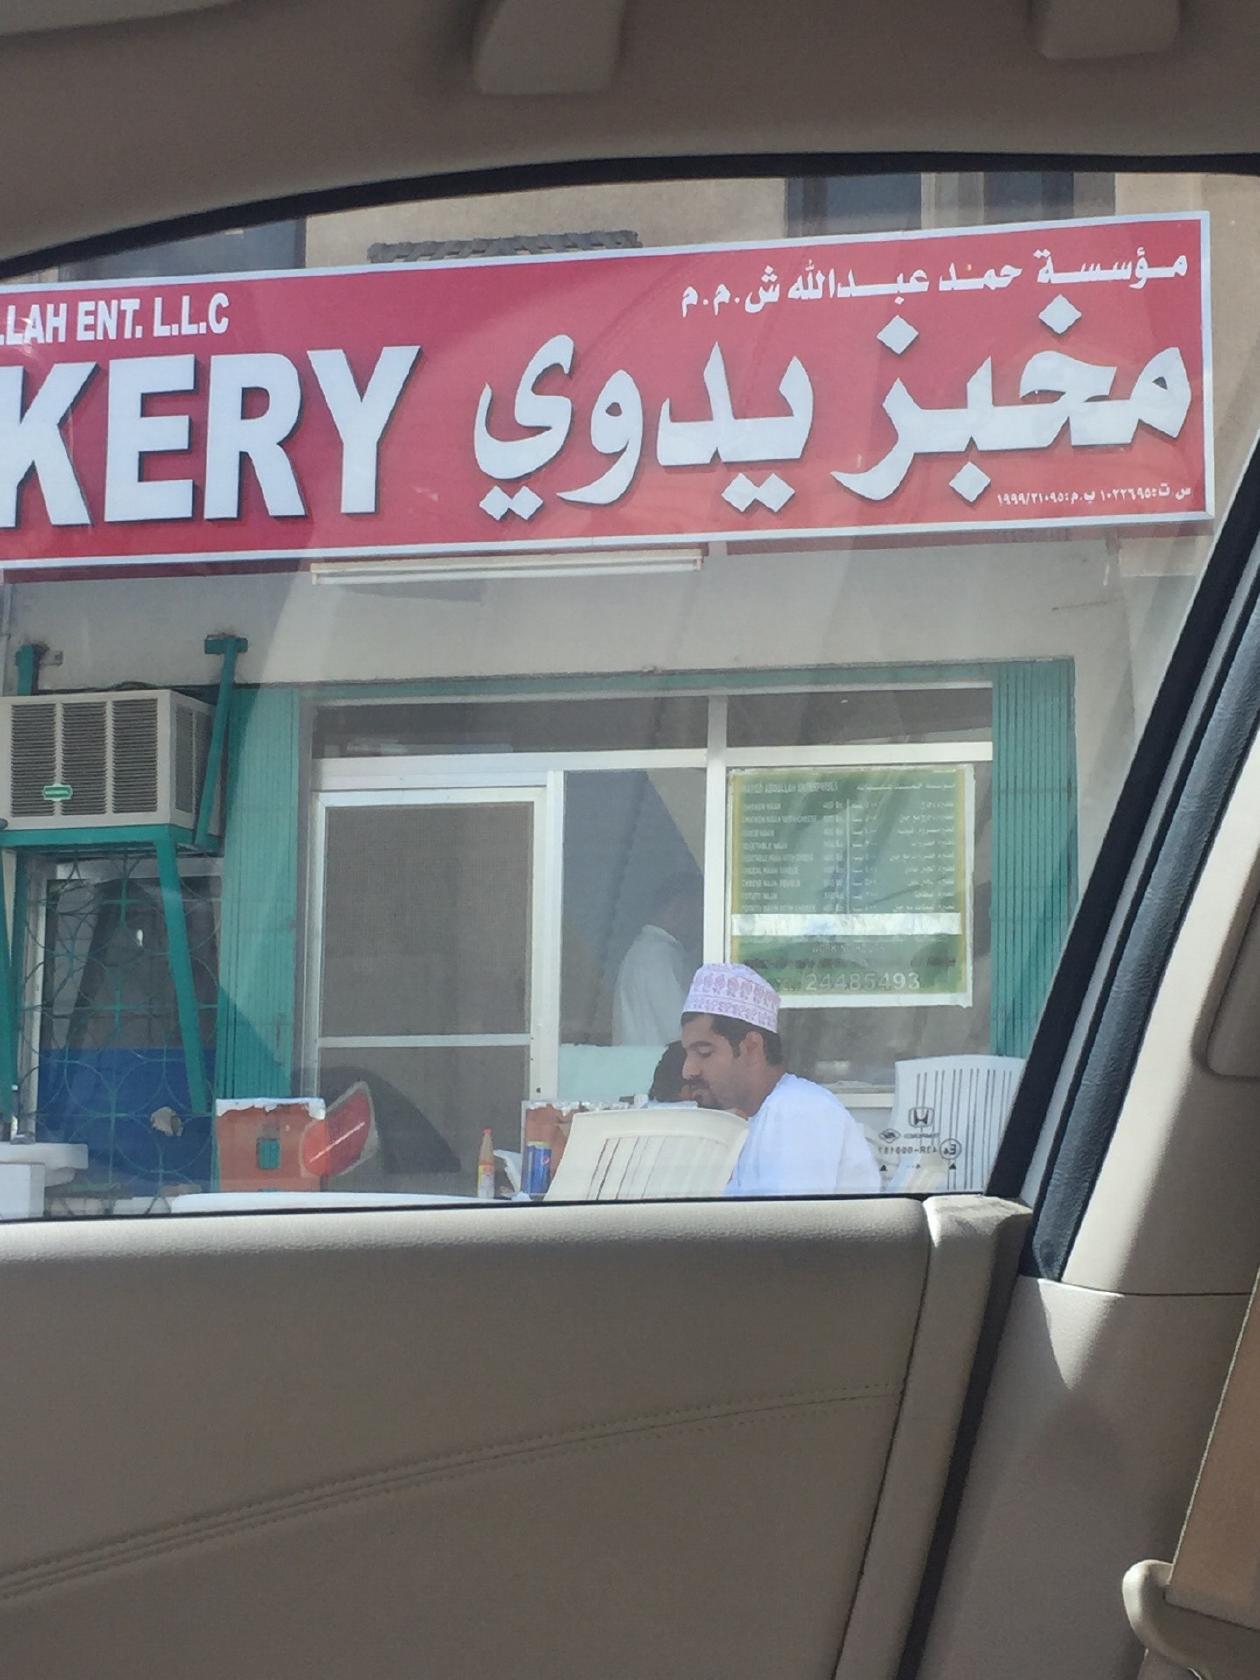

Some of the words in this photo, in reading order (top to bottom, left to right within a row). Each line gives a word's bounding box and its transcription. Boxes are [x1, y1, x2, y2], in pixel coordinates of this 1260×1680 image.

[0, 304, 67, 345] LAH
[76, 298, 143, 341] ENT.
[153, 292, 229, 337] L.L.C
[1033, 246, 1188, 289] مؤسسة
[0, 344, 421, 528] KERY
[474, 334, 814, 521] يدوي
[830, 292, 1191, 503] مخبز
[805, 971, 921, 992] 24485493
